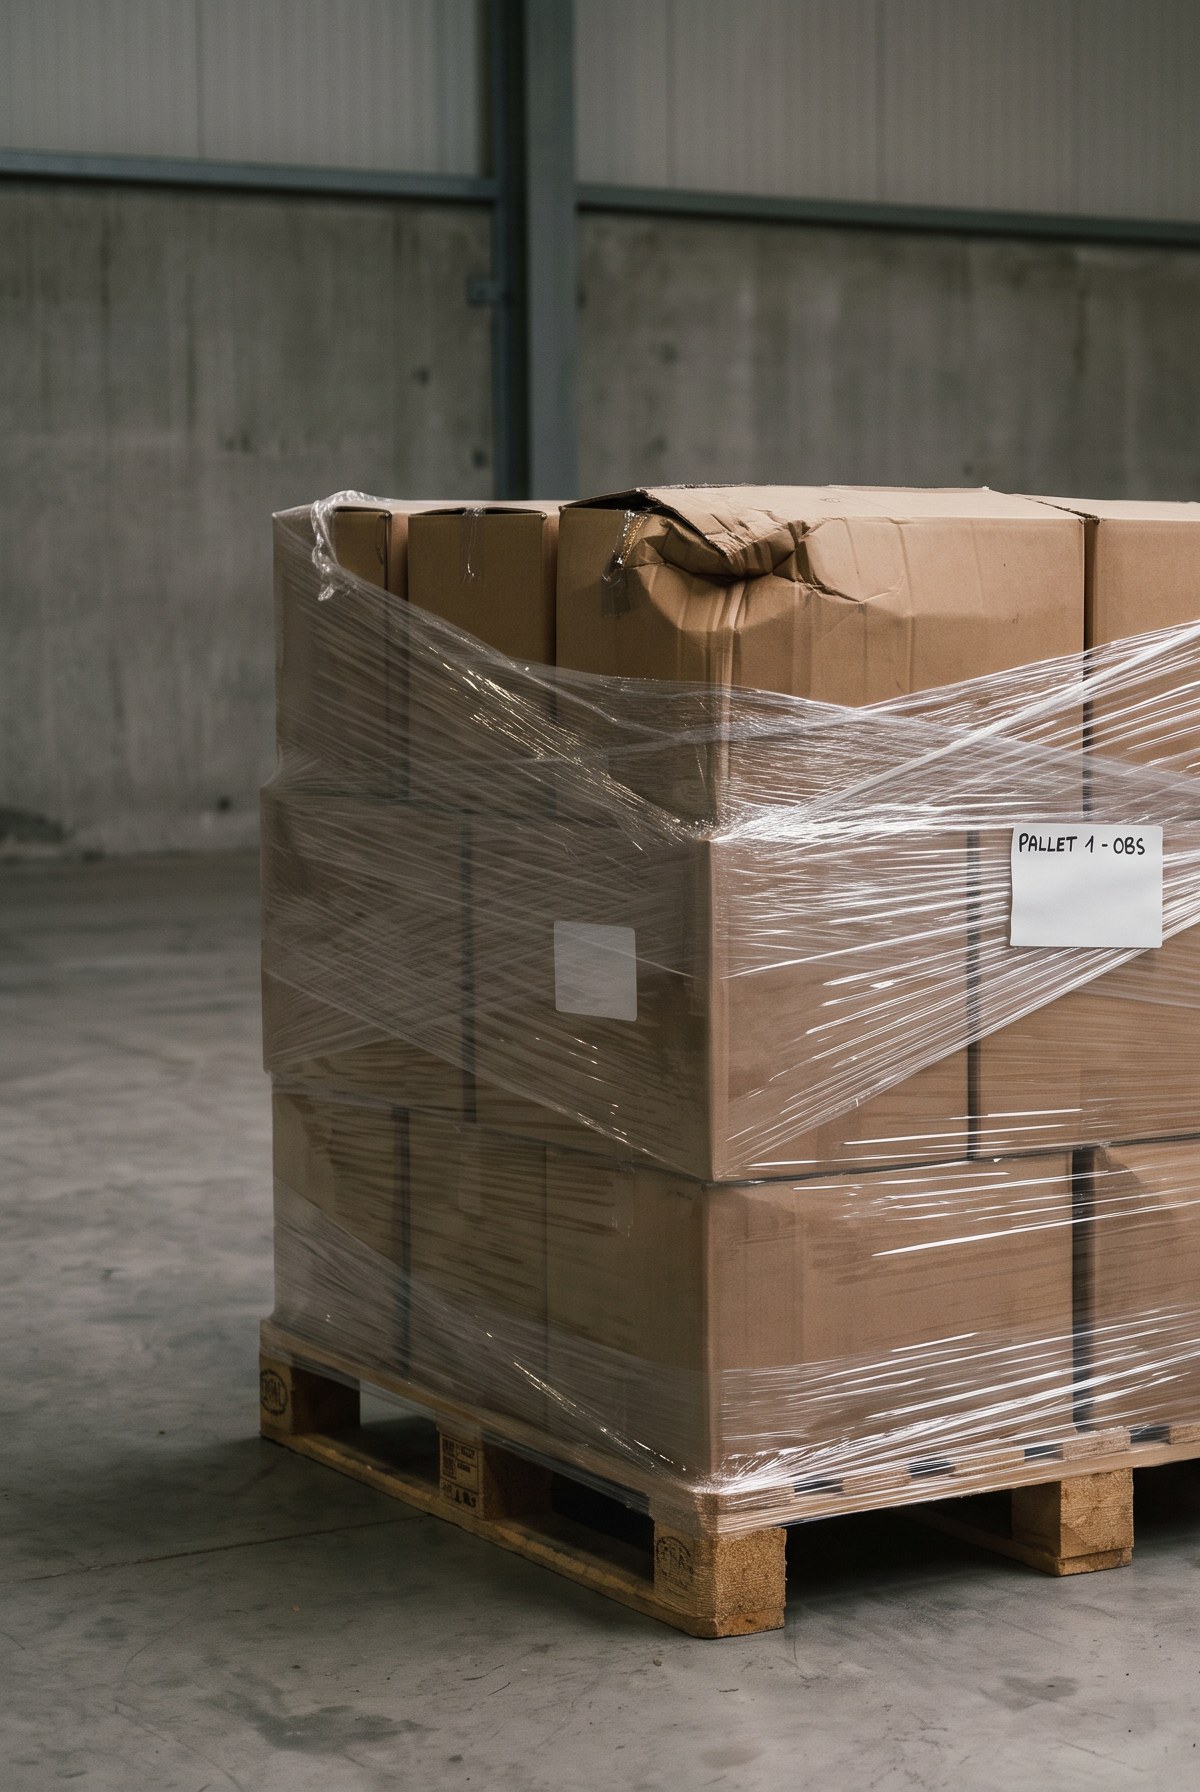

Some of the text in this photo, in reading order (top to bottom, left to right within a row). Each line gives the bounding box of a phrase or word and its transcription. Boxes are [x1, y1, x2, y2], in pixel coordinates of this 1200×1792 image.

[1018, 832, 1078, 853] PALLET
[1084, 834, 1095, 854] 1
[1112, 836, 1146, 856] OBS
